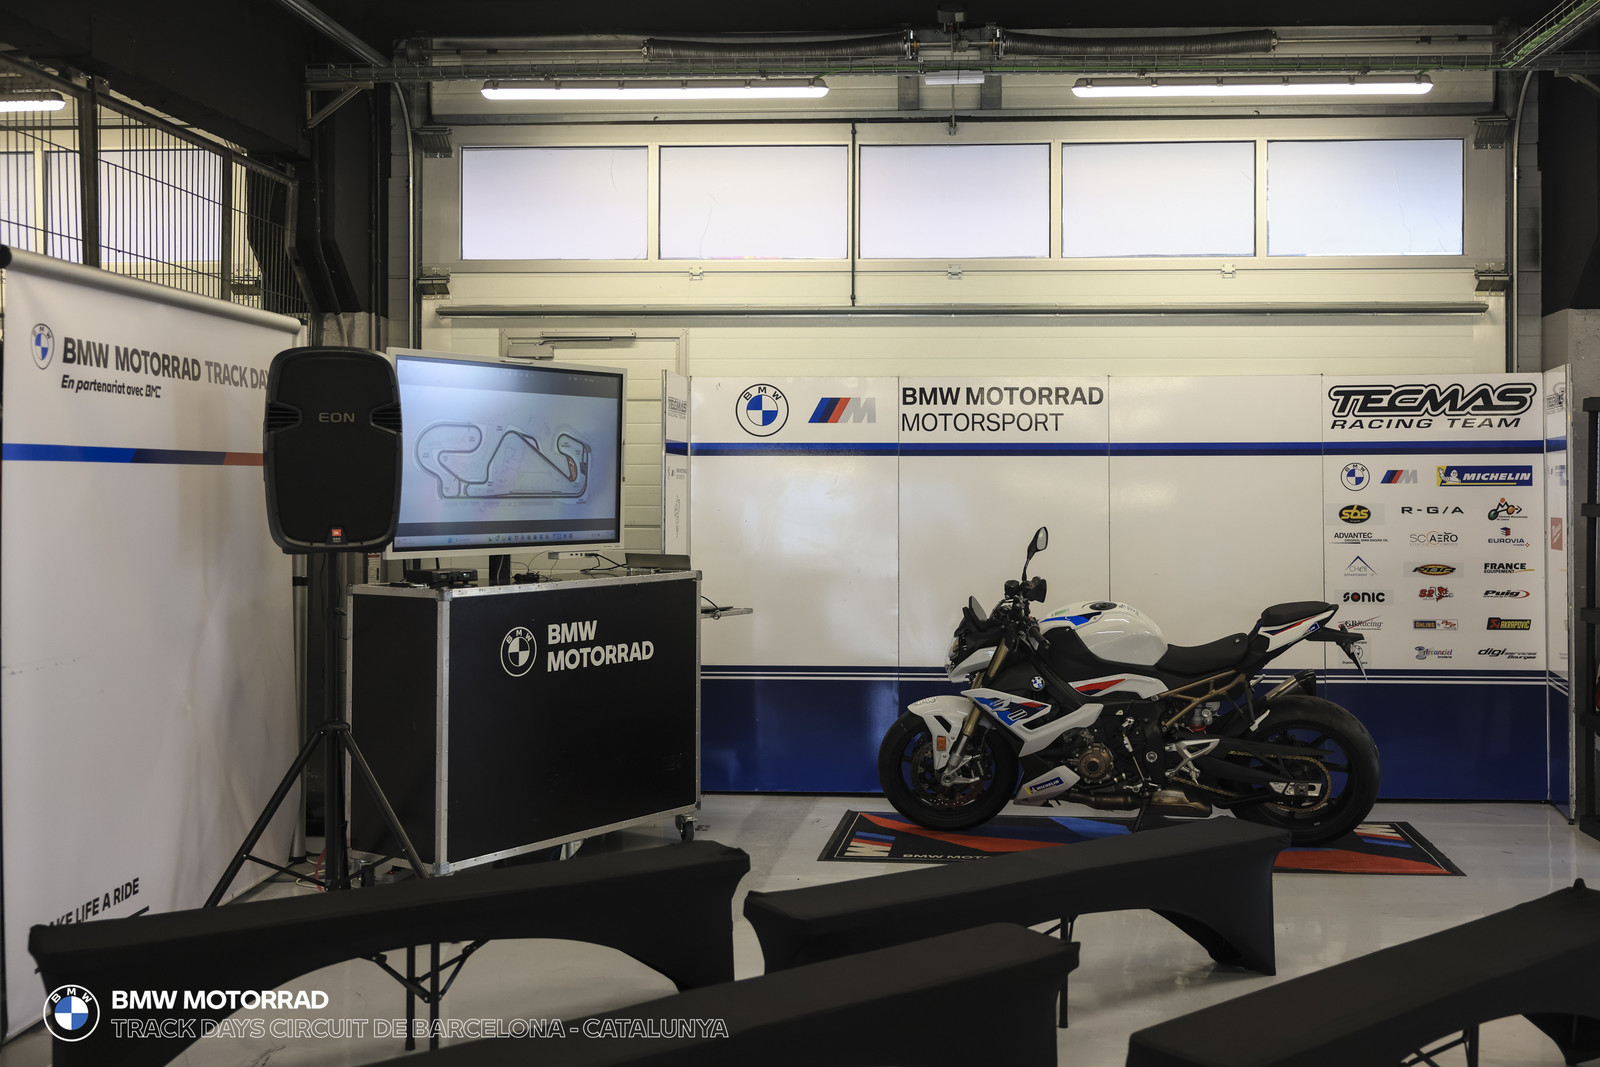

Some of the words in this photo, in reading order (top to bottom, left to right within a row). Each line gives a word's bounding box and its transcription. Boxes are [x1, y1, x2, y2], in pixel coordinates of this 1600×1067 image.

[62, 336, 110, 369] BMW
[115, 345, 201, 382] MOTORRAD
[205, 360, 249, 389] TRACK
[61, 374, 75, 389] En
[75, 379, 126, 394] partenariat
[126, 385, 144, 397] avec
[145, 384, 161, 399] BMC
[743, 386, 782, 401] BMW
[902, 387, 961, 406] BMW
[966, 386, 1104, 406] MOTORRAD
[1329, 384, 1536, 416] TECMAS
[318, 412, 356, 423] EON
[901, 413, 1064, 432] MOTORSPORT
[1330, 418, 1434, 430] RACING
[1447, 417, 1521, 429] TEAM
[1462, 472, 1531, 481] MICHELIN
[1340, 505, 1369, 520] sbs
[1483, 562, 1527, 570] FRANCE
[1343, 592, 1385, 602] SONIC
[1483, 589, 1521, 598] Puig
[506, 629, 533, 644] BMW
[547, 620, 598, 645] BMW
[547, 640, 655, 673] MOTORRAD
[1477, 647, 1507, 657] digi
[75, 896, 100, 923] LIFE
[102, 892, 111, 912] A
[113, 876, 140, 906] RIDE
